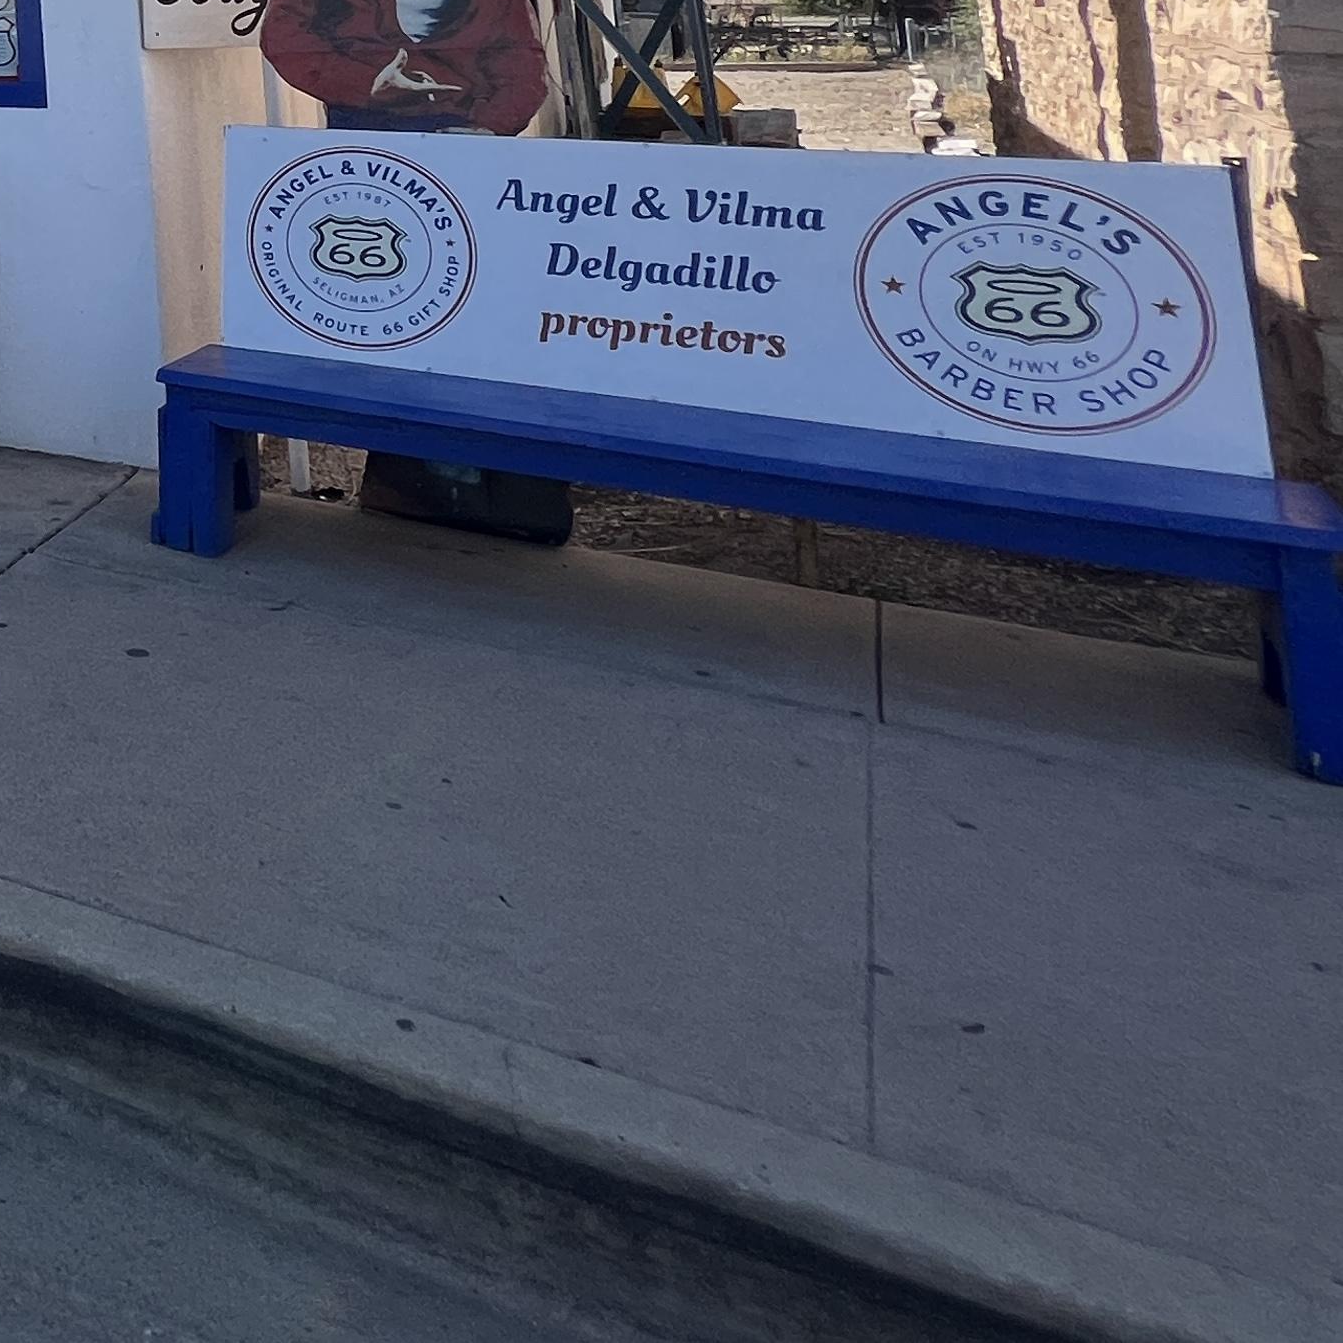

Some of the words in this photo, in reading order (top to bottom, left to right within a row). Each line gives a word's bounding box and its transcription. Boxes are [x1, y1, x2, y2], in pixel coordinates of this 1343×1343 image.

[268, 164, 333, 220] ANGEL
[340, 160, 356, 175] &
[366, 161, 452, 231] VILMA'S
[324, 192, 349, 205] EST
[357, 191, 392, 207] 1987
[496, 178, 617, 225] Angel
[631, 186, 669, 221] &
[686, 187, 827, 232] Vilma
[906, 191, 1142, 256] ANGEL'S
[956, 231, 1002, 255] EST
[1018, 232, 1084, 261] 1950
[329, 243, 386, 267] 66
[547, 242, 781, 295] Delgadillo
[262, 241, 303, 312] ORIGINAL
[313, 311, 369, 336] ROUTE
[382, 323, 404, 335] 66
[408, 298, 441, 326] GIFT
[438, 255, 461, 296] SHOP
[389, 284, 406, 298] AZ
[984, 296, 1071, 328] 66
[539, 309, 787, 359] proprietors
[966, 340, 997, 364] ON
[1008, 359, 1061, 374] HWY
[1072, 350, 1100, 368] 66
[896, 328, 1057, 415] BARBER
[1078, 348, 1173, 413] SHOP
